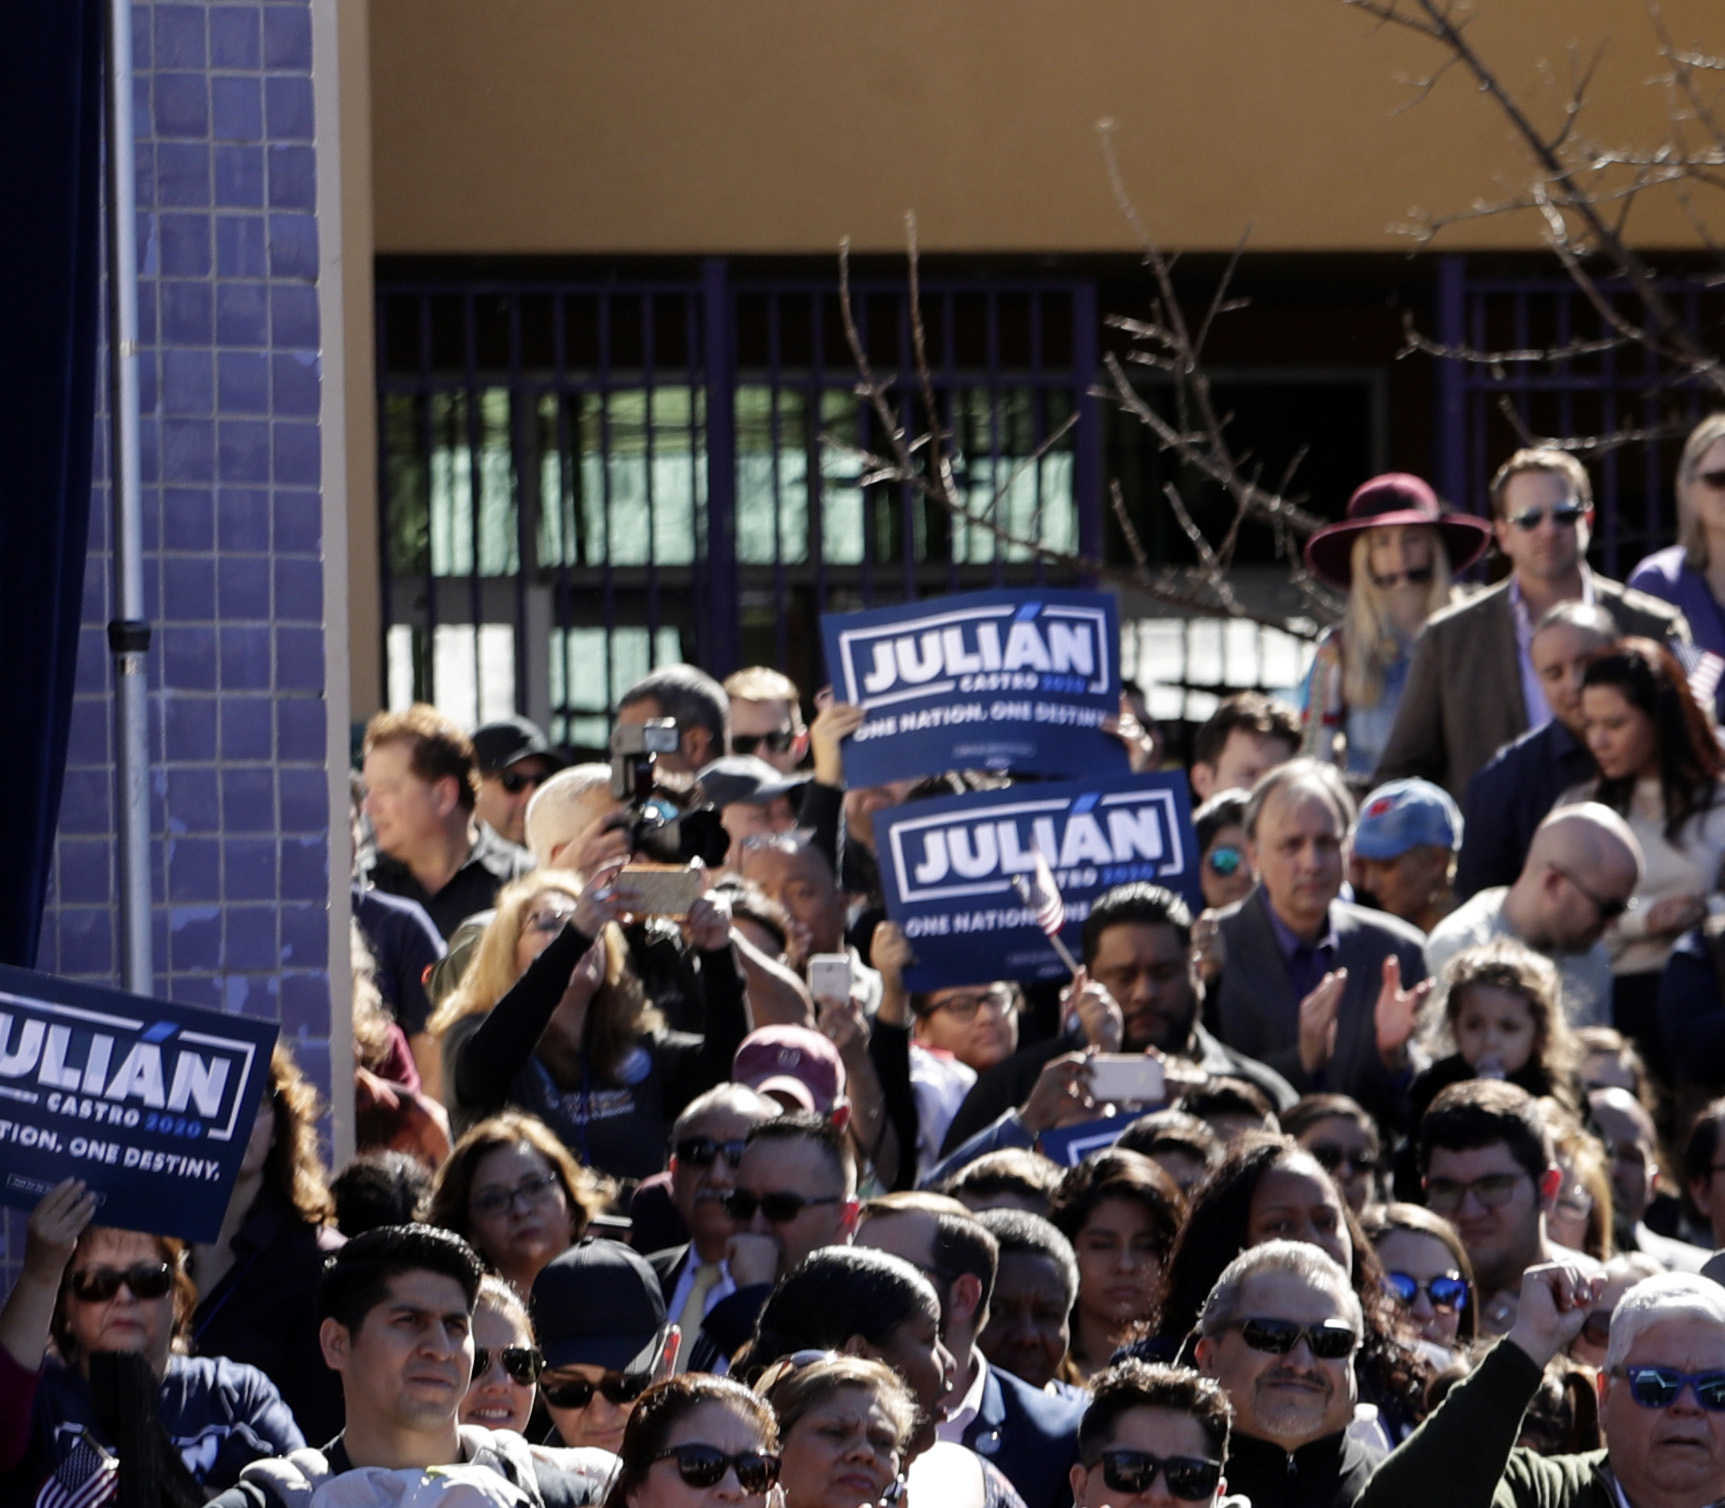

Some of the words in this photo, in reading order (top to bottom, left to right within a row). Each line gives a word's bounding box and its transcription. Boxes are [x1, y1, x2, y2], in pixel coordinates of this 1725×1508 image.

[864, 602, 1094, 693] JULIÁN
[960, 672, 1039, 693] CASTRO
[989, 700, 1033, 722] ONE
[915, 792, 1163, 884] JULIÁN
[905, 915, 951, 939] ONE
[47, 1092, 140, 1128] CASTRO
[144, 1111, 202, 1138] 2020
[69, 1137, 119, 1163] ONE
